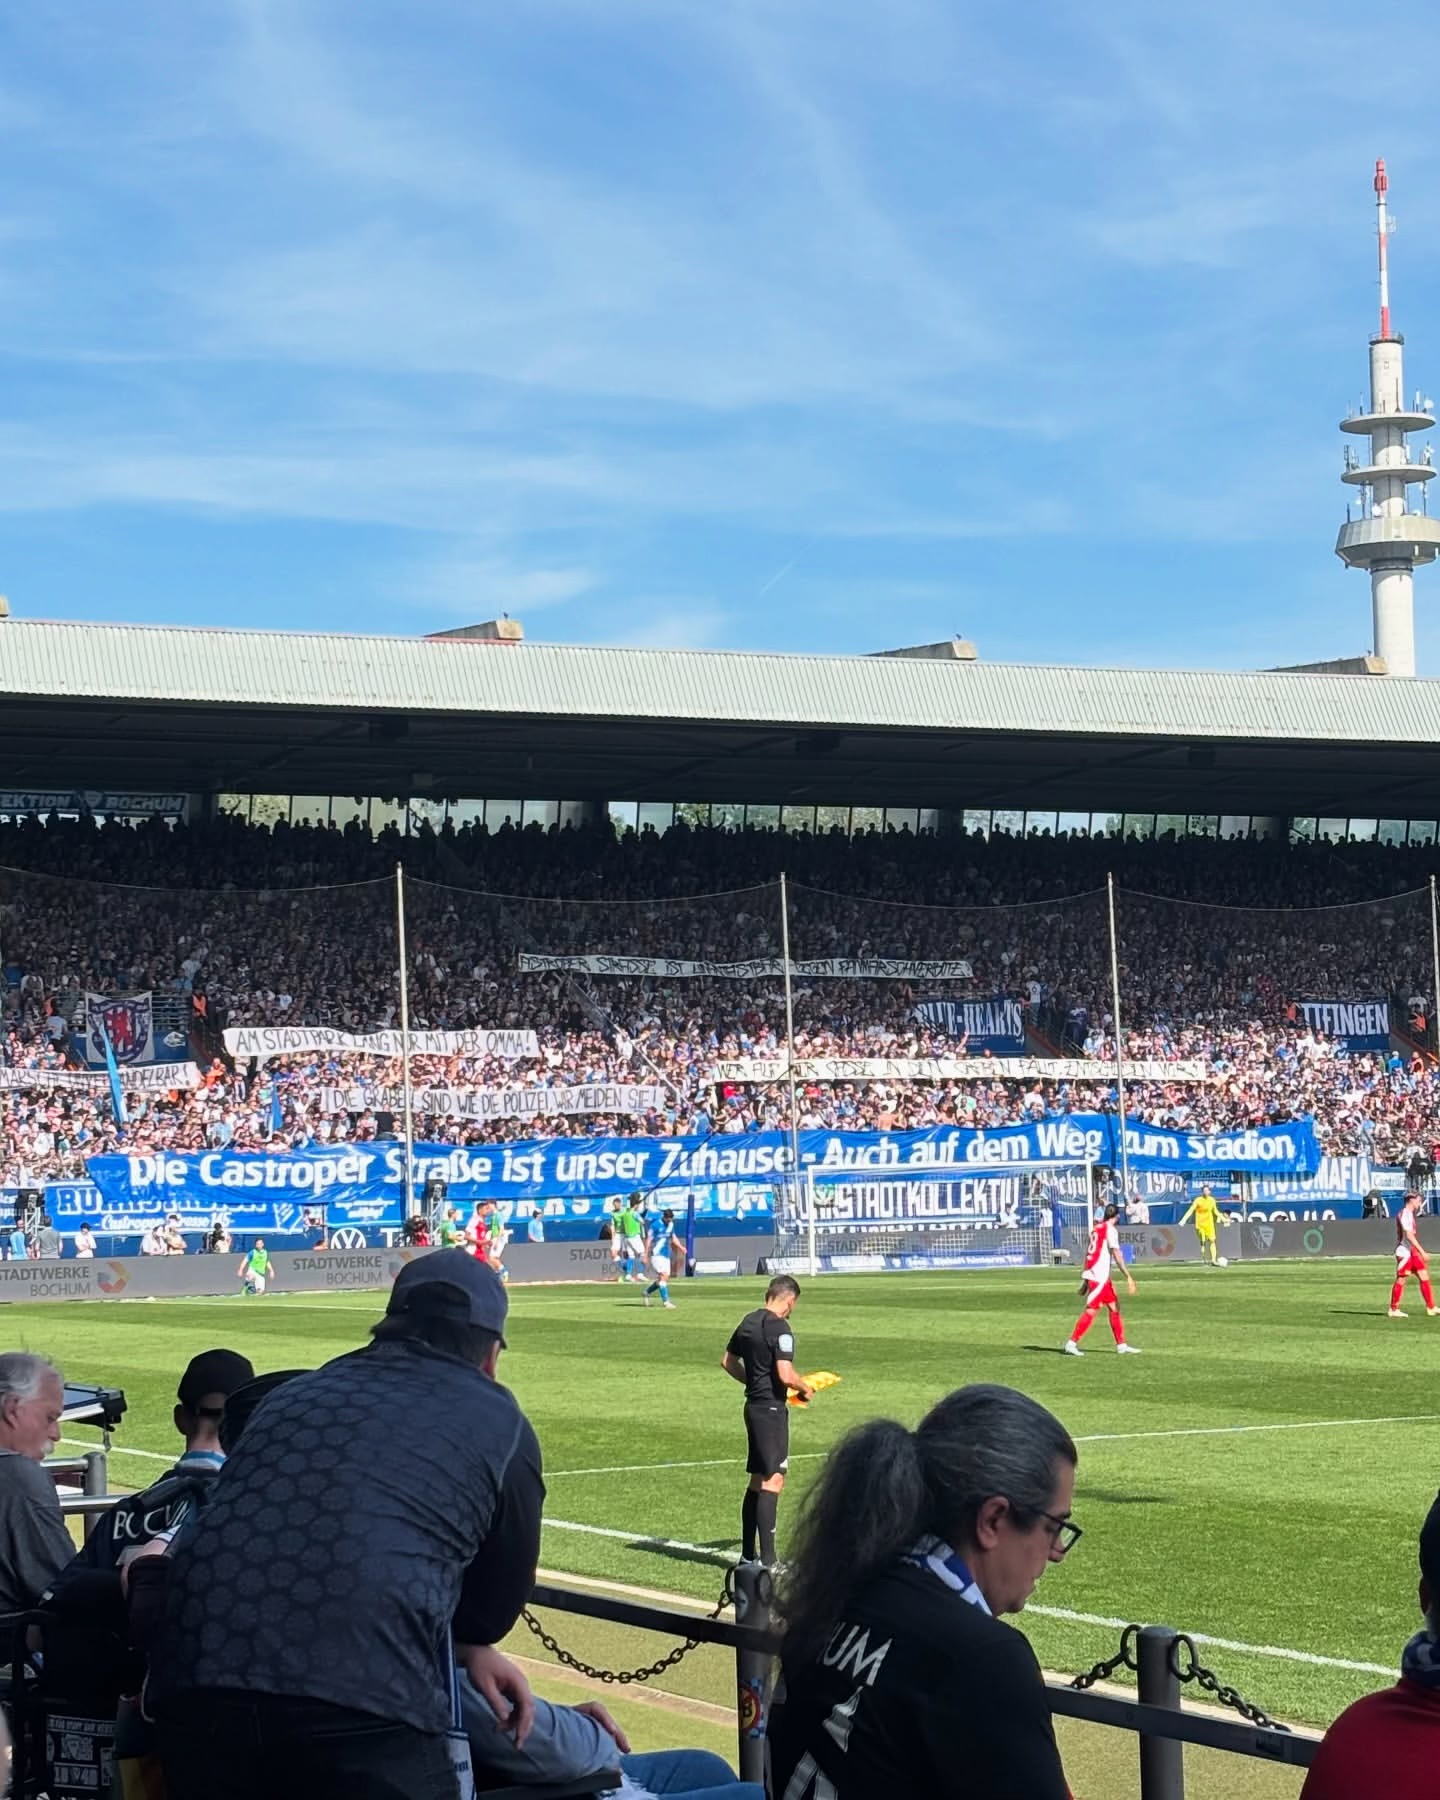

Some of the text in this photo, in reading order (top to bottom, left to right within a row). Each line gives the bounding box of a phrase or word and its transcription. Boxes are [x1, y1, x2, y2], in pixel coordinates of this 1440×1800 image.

[0, 793, 183, 811] EKTION BOCHUM
[236, 1030, 262, 1053] AM
[353, 1032, 389, 1052] LANG
[426, 1032, 449, 1051] MIT
[422, 1091, 451, 1114] SIND
[457, 1094, 477, 1114] WIE
[481, 1092, 501, 1114] DIE
[129, 1154, 186, 1186] Die
[199, 1154, 375, 1193] Castroper
[384, 1147, 492, 1185] Straße
[502, 1149, 545, 1182] ist
[556, 1149, 649, 1182] unser
[658, 1141, 796, 1180] Zuhause
[822, 1136, 900, 1168] Auch
[905, 1132, 960, 1166] auf
[967, 1130, 1029, 1162] dem
[1037, 1123, 1102, 1161] Weg
[1117, 1128, 1180, 1158] zum
[1187, 1130, 1296, 1161] Stadion
[293, 1255, 382, 1270] STADTWERKE
[0, 1266, 90, 1281] TADTWERKE
[326, 1271, 383, 1285] BOCHUM
[30, 1283, 91, 1297] BOCHUM
